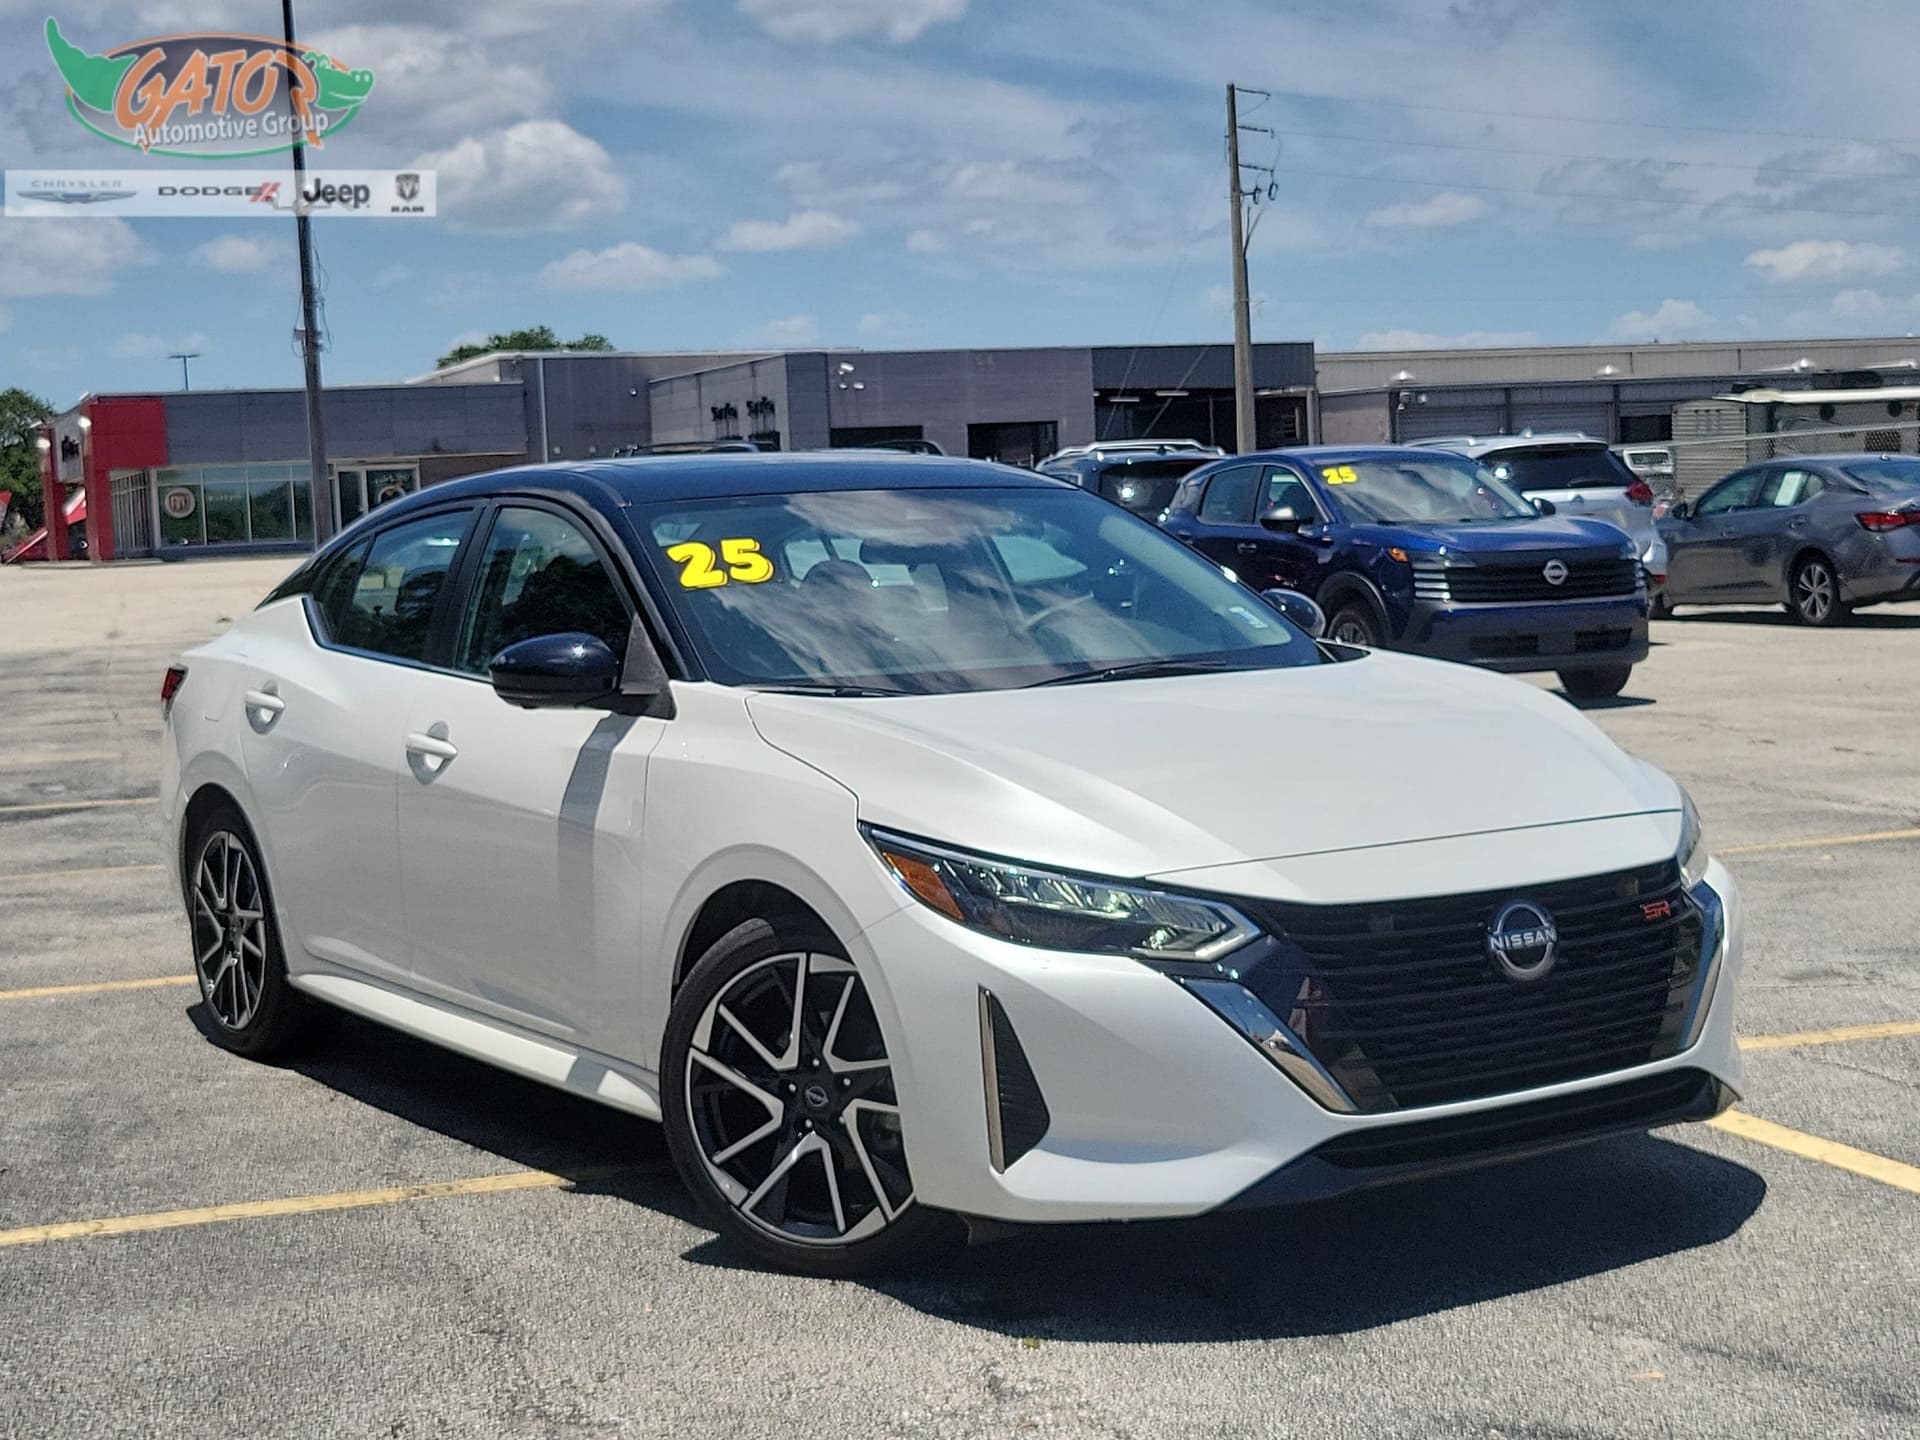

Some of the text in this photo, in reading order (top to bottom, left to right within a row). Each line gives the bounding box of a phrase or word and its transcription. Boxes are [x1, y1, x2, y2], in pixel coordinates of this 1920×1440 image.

[1322, 465, 1358, 485] 25
[666, 537, 775, 590] 25
[1643, 901, 1671, 921] SR
[1489, 926, 1558, 951] NISSAN
